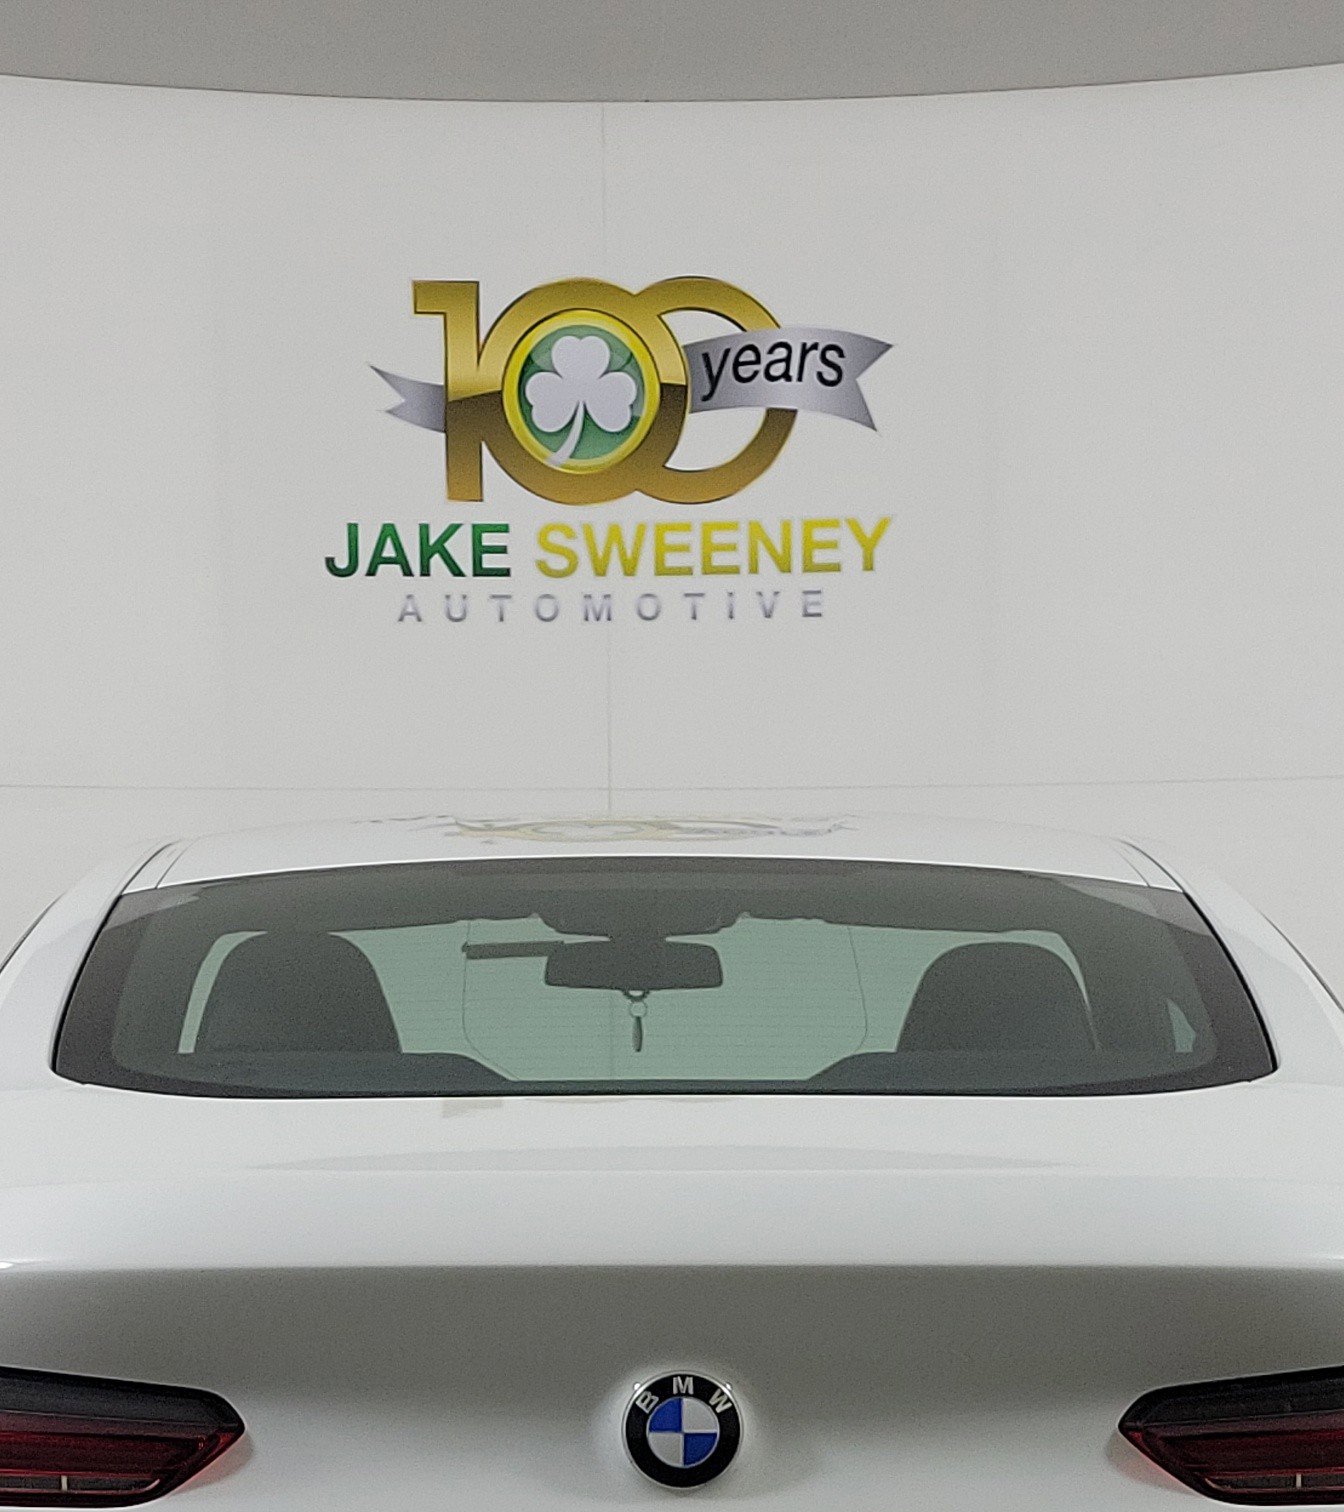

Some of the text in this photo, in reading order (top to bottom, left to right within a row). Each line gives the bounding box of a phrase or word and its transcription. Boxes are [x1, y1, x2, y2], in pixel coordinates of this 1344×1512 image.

[412, 275, 846, 505] 100 years
[325, 516, 894, 578] JAKE SWEENEY
[397, 588, 825, 623] AUTOMOTIVE
[635, 1376, 733, 1414] BMW
